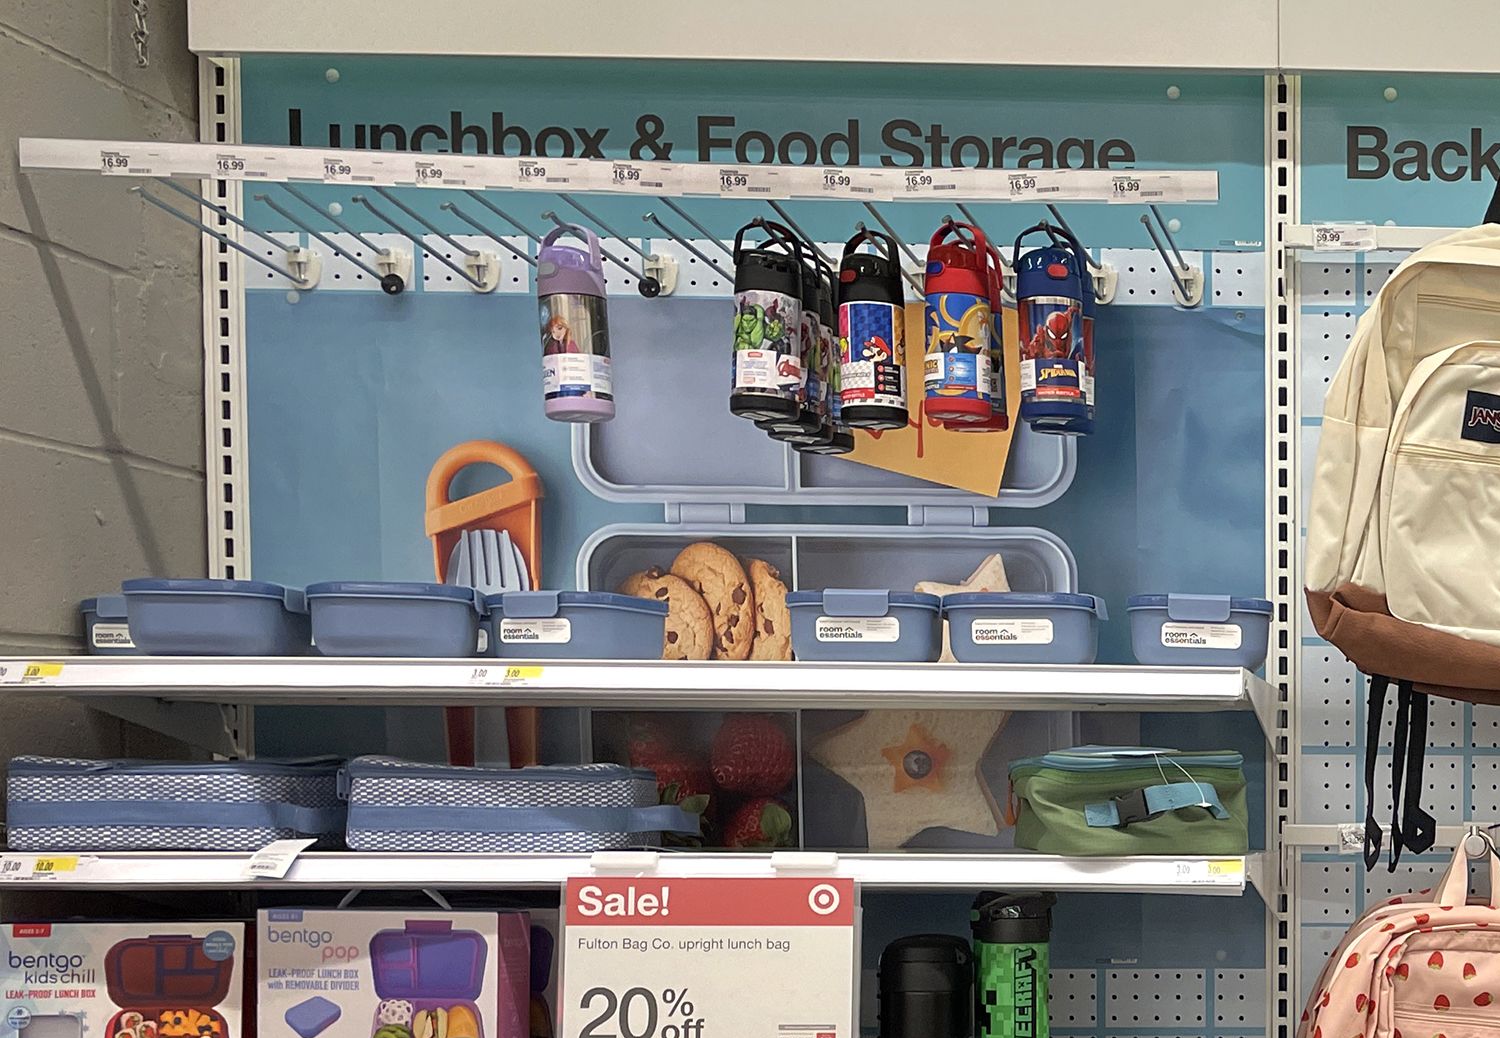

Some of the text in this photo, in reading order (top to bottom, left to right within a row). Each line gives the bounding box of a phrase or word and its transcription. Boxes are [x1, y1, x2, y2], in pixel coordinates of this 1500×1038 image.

[289, 108, 1136, 169] Lunchbox & Food Storage
[101, 157, 128, 169] 16.99
[216, 160, 244, 171] 16.99
[324, 164, 351, 176] 16.99
[415, 168, 442, 179] 16.99
[519, 167, 546, 178] 16.99
[612, 170, 640, 181] 16.99
[719, 176, 747, 187] 16.99
[823, 175, 851, 186] 16.99
[905, 175, 933, 187] 16.99
[1009, 178, 1036, 191] 16.99
[1112, 181, 1140, 192] 16.99
[503, 632, 540, 640] essentials
[819, 631, 863, 639] essentials
[975, 633, 1018, 641] essentials
[1164, 637, 1207, 645] essentials
[472, 668, 488, 679] 3.00
[35, 861, 55, 872] 10.00
[577, 885, 670, 917] Sale!
[267, 926, 333, 949] bentgo
[578, 938, 791, 952] Fulton Bag Co. upright lunch bag
[322, 946, 360, 963] pop
[8, 951, 83, 973] bentgo
[24, 969, 96, 984] kids chill
[268, 968, 360, 980] LEAK-PROOF LUNCH BOX
[267, 980, 360, 991] with REMOVABLE DIVIDER
[5, 989, 96, 999] LEAK-PROOF LUNCH BOX
[661, 988, 695, 1018] %
